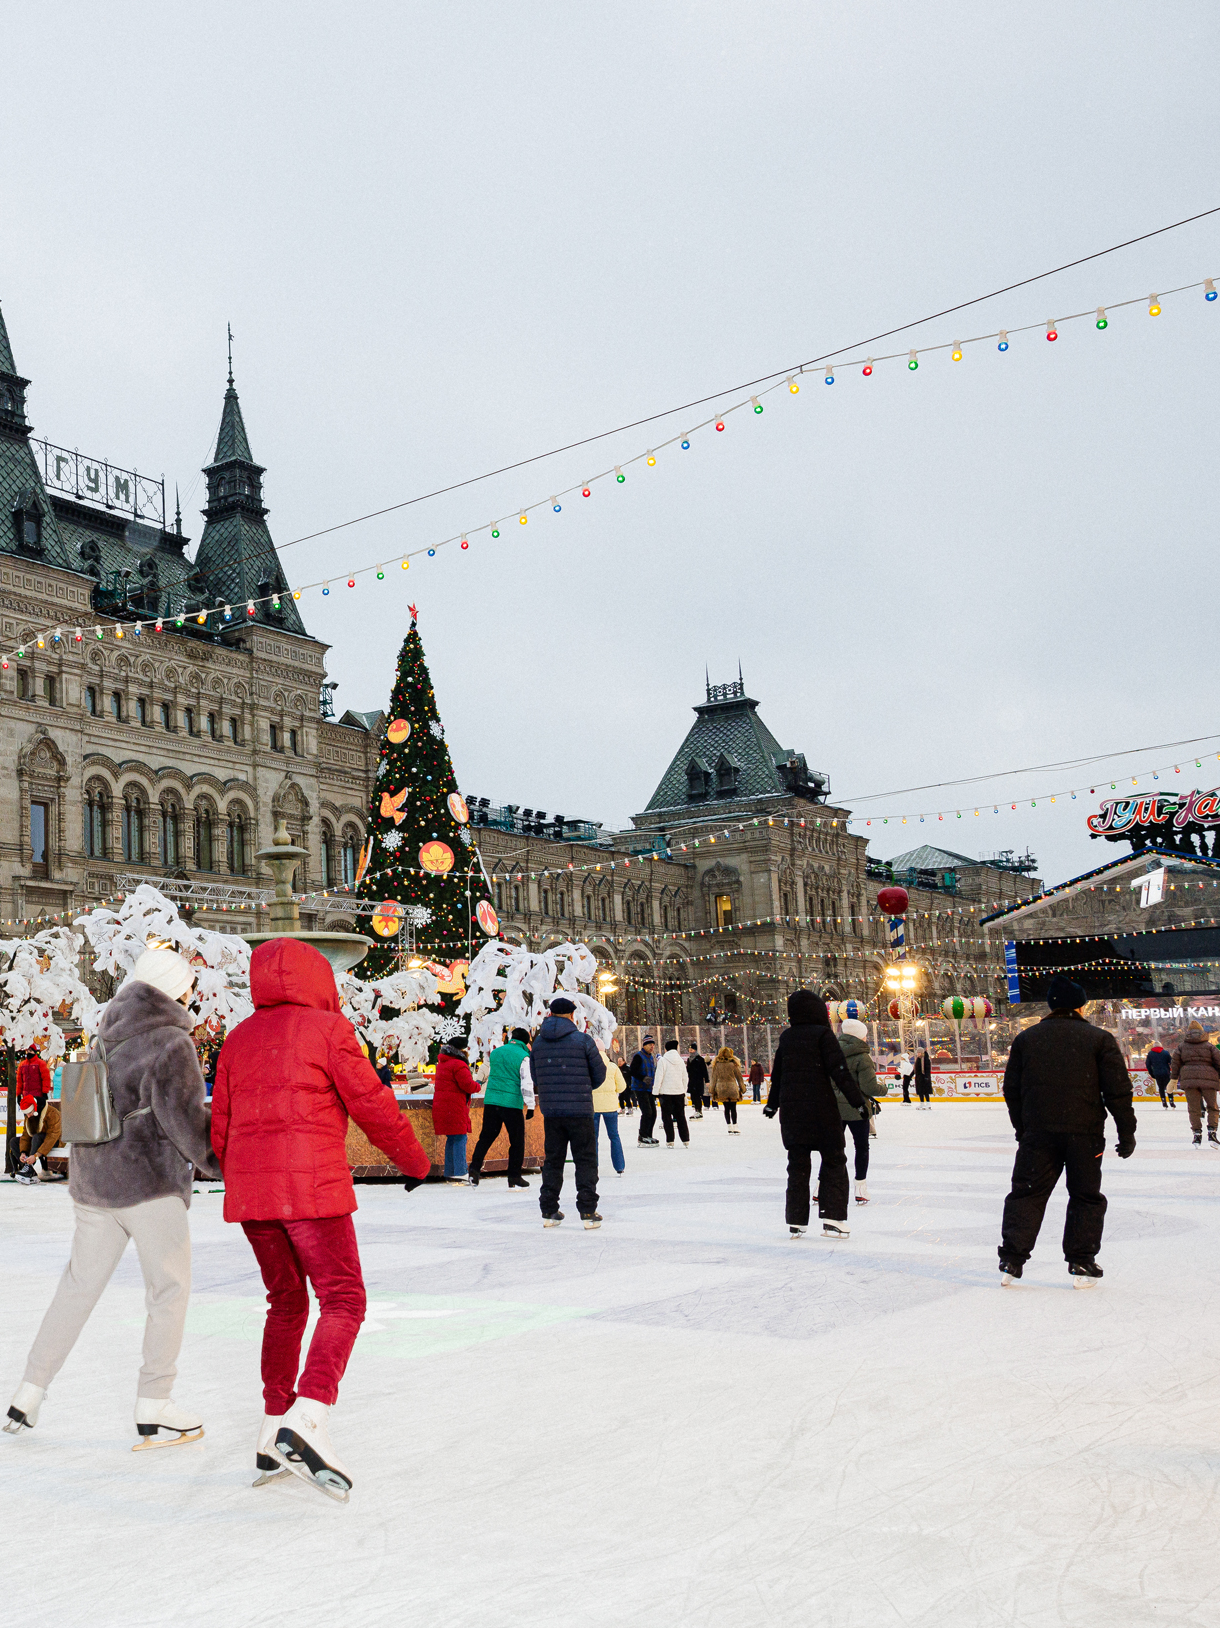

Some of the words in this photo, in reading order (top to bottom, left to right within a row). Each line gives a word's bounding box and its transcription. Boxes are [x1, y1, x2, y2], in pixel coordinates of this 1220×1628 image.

[55, 454, 130, 504] ГУМ
[1087, 788, 1220, 835] ГУМ-Ка
[1121, 1004, 1184, 1019] ПЕРВЫЙ
[1187, 1006, 1220, 1018] КАН
